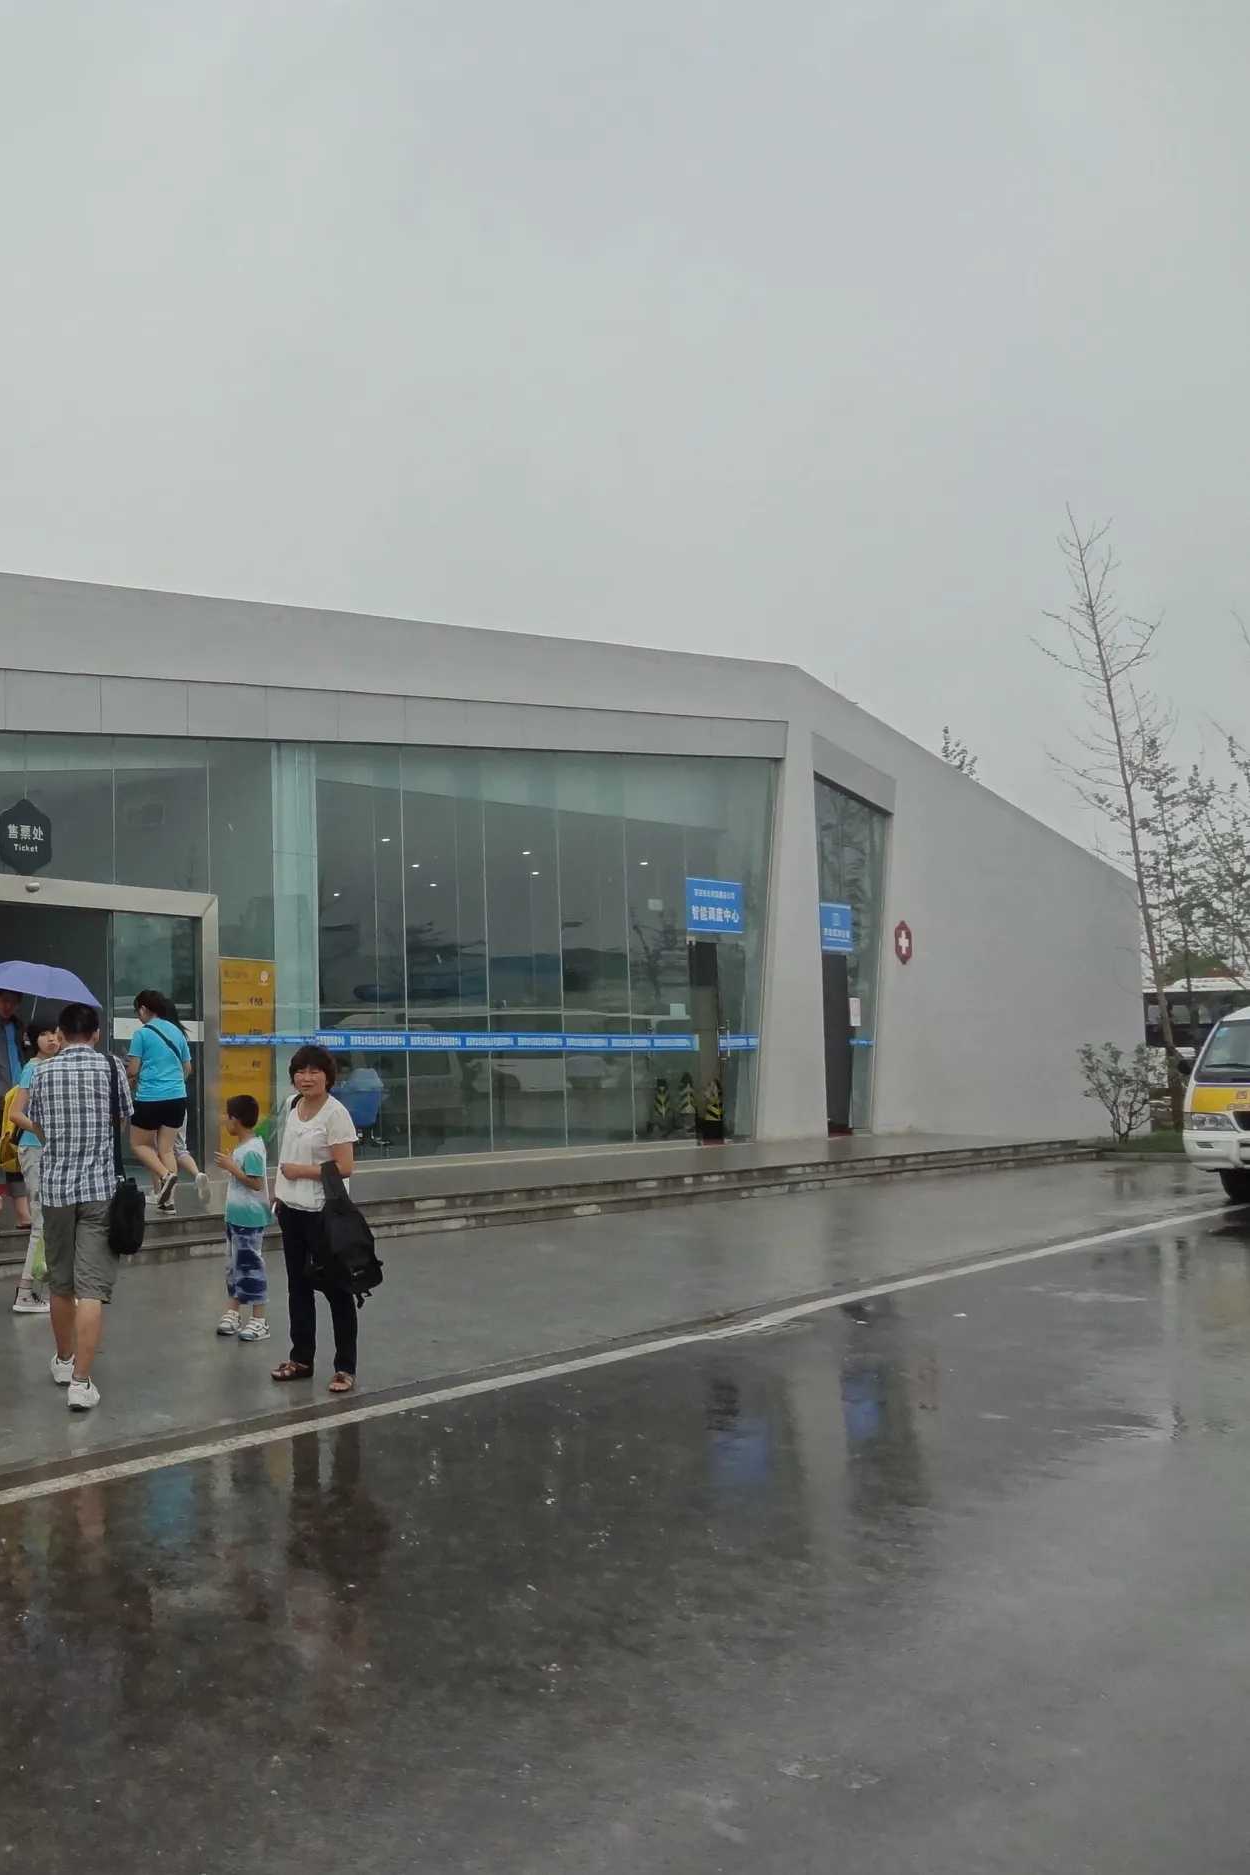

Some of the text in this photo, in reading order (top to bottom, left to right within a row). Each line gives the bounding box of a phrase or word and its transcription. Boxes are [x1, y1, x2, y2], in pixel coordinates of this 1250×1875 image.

[7, 824, 44, 841] 售票处
[14, 843, 39, 853] Ticket
